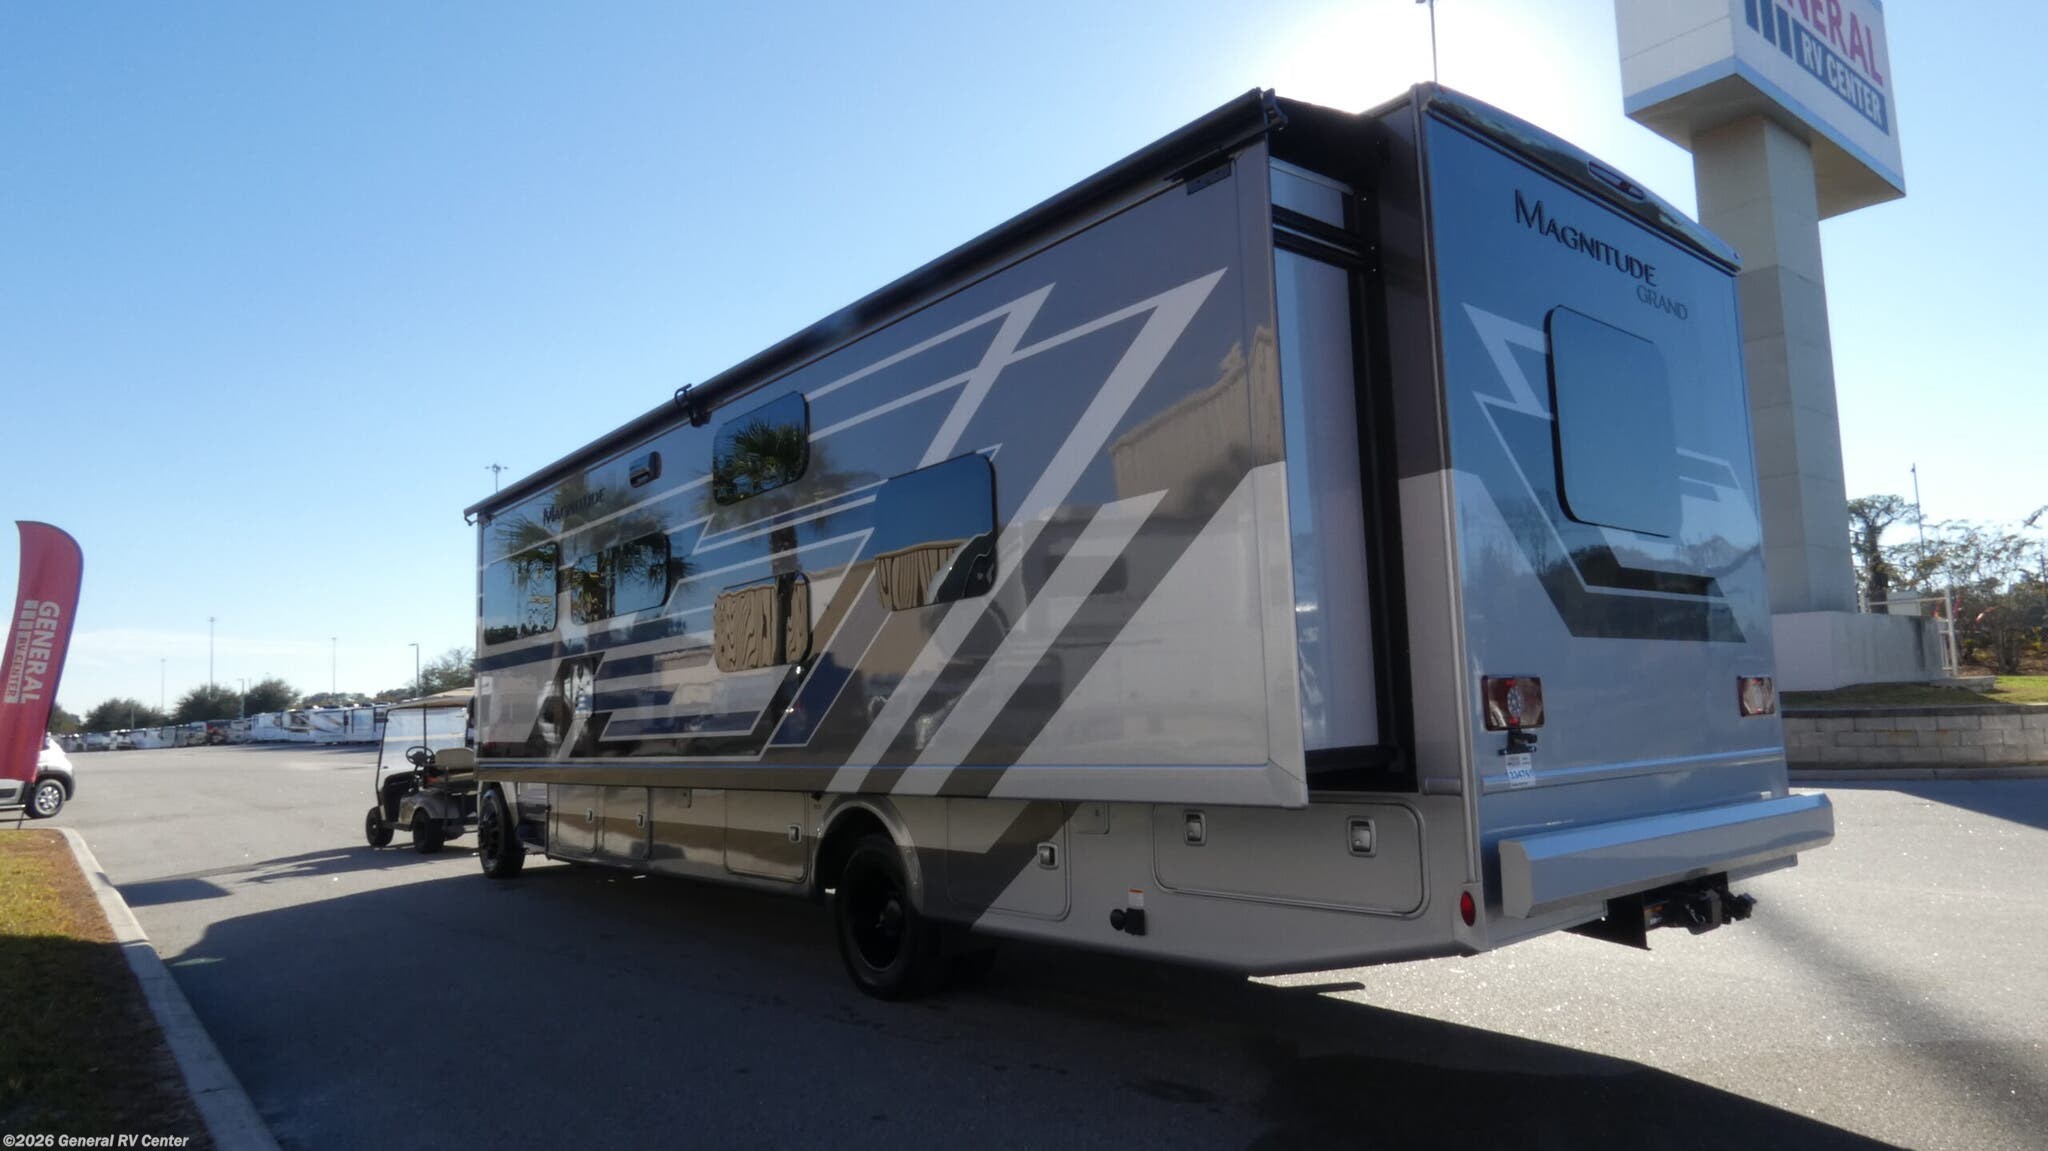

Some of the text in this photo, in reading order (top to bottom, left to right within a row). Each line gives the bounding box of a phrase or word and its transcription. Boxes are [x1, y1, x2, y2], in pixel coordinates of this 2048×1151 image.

[1787, 0, 1883, 87] ERAL
[1800, 31, 1884, 127] RV CENTER
[1514, 189, 1657, 287] MAGNITUDE
[1636, 285, 1688, 320] GRAND
[8, 654, 24, 697] CENTER
[20, 600, 60, 704] GENERAL
